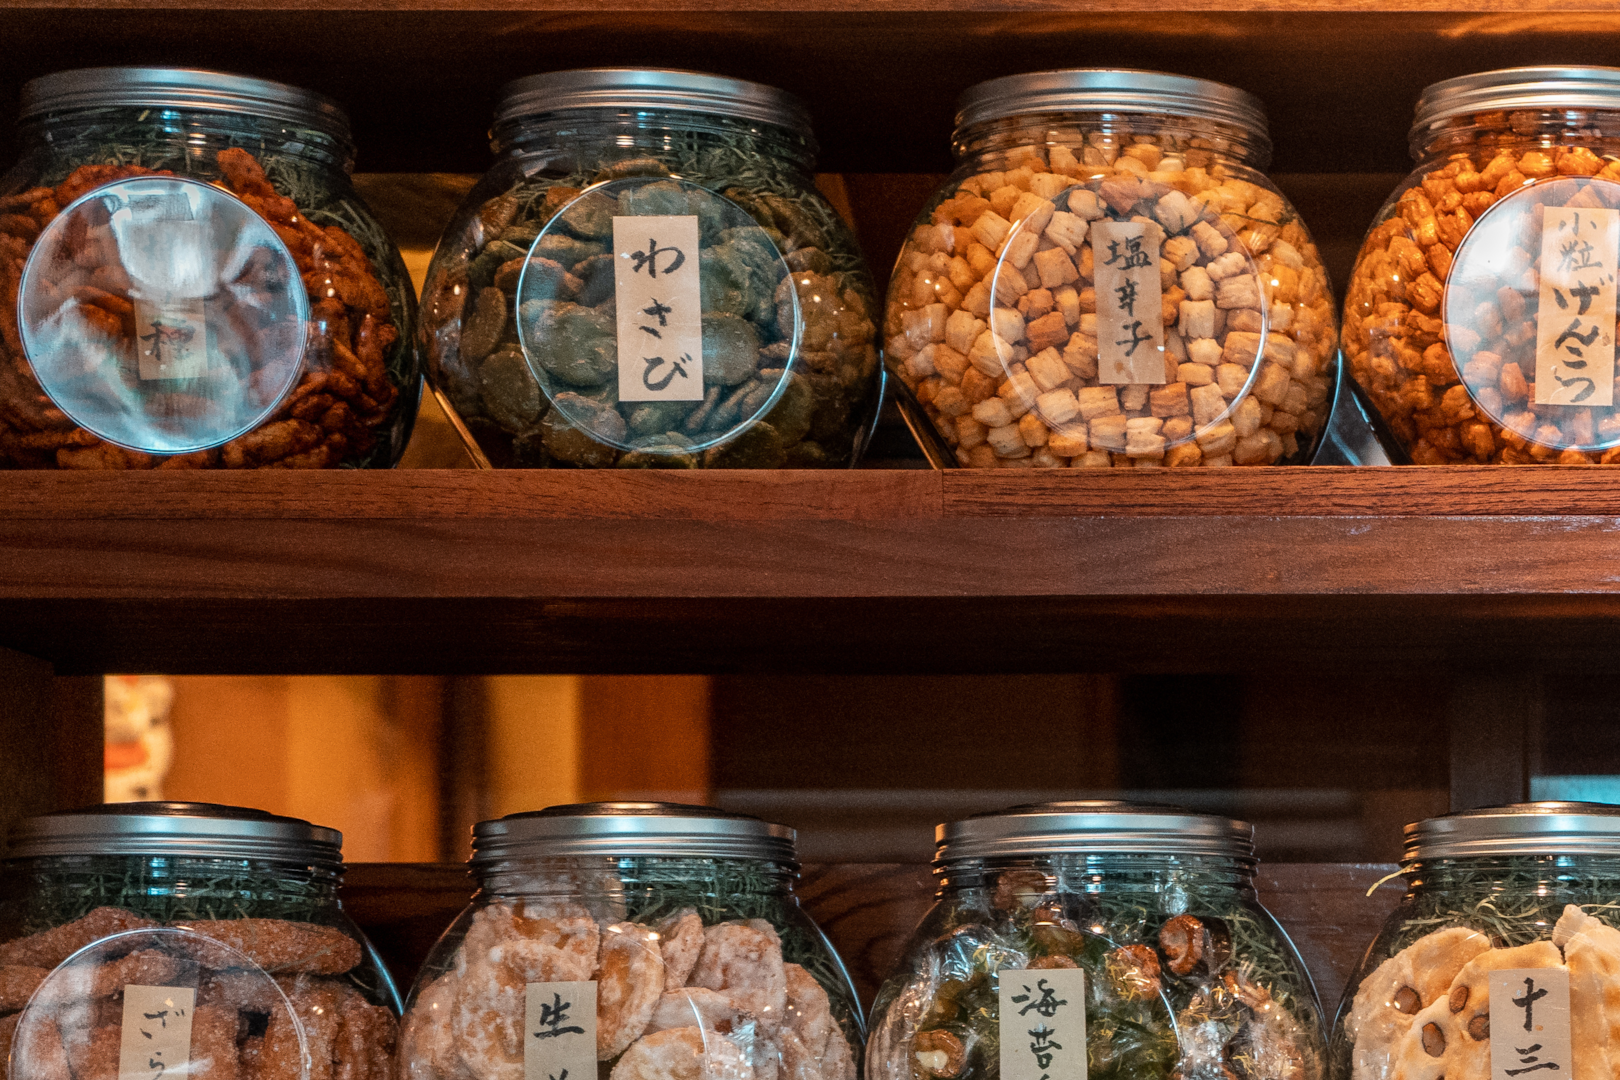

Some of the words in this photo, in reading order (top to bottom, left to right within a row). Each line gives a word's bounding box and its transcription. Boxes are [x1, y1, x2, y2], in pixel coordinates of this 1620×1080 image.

[630, 238, 692, 391] わさび
[1103, 235, 1153, 357] 塩辛子
[1554, 212, 1614, 402] 小粒げんこつ
